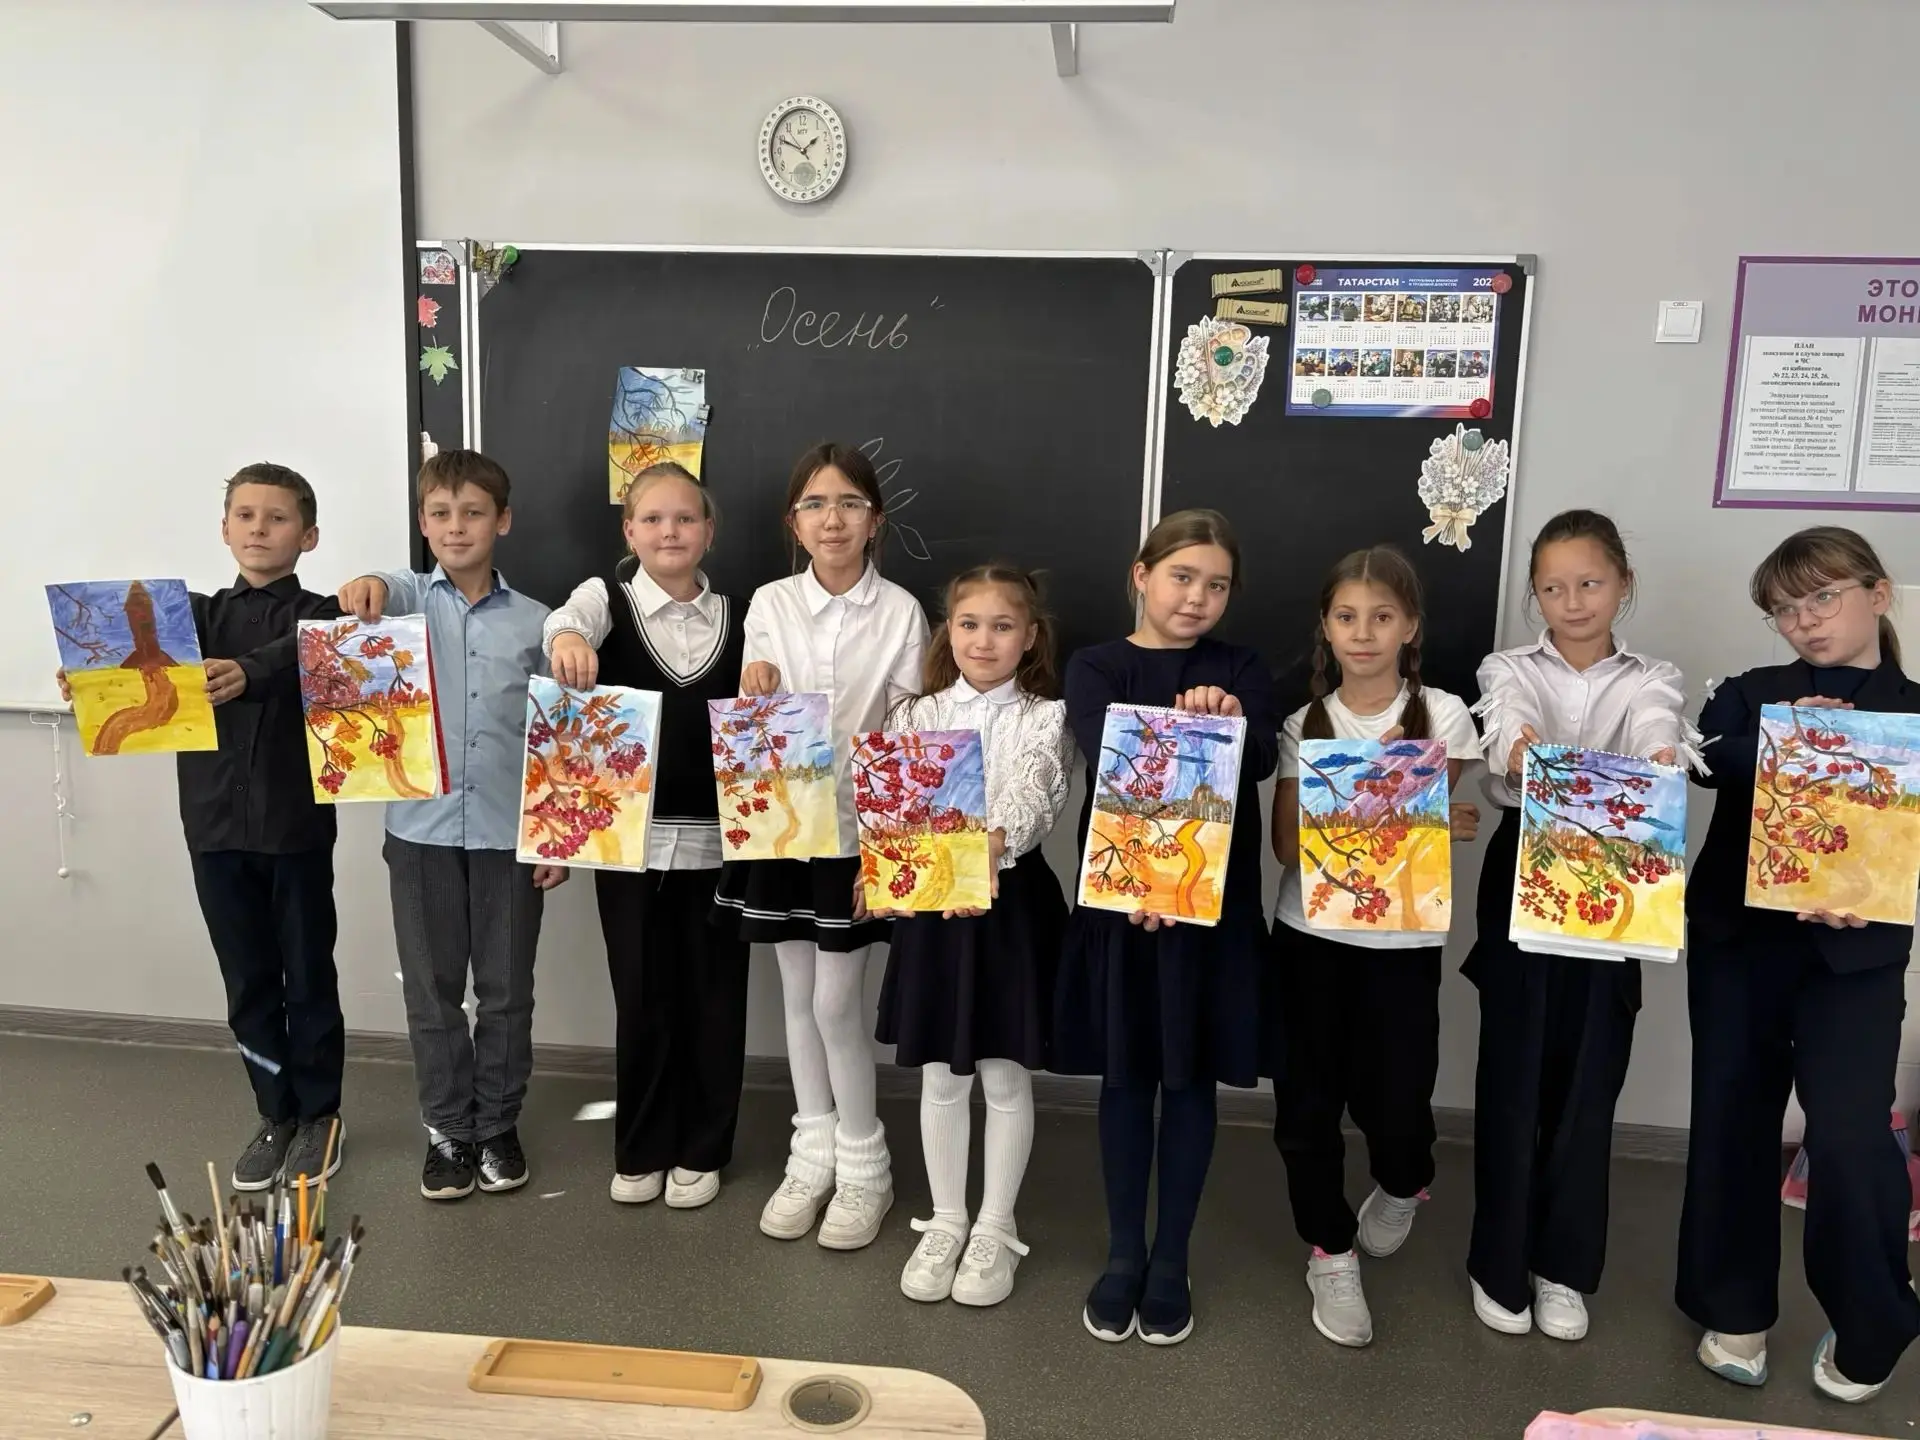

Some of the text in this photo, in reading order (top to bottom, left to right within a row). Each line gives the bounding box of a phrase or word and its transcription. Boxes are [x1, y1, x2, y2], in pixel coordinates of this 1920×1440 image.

[799, 115, 807, 126] 12
[786, 122, 792, 133] 11
[823, 131, 828, 142] 2
[827, 144, 831, 153] 3
[1338, 278, 1399, 286] ТАТАРСТАН
[1473, 278, 1492, 287] 202
[1867, 279, 1919, 297] ЭТО
[1858, 305, 1920, 323] МОН
